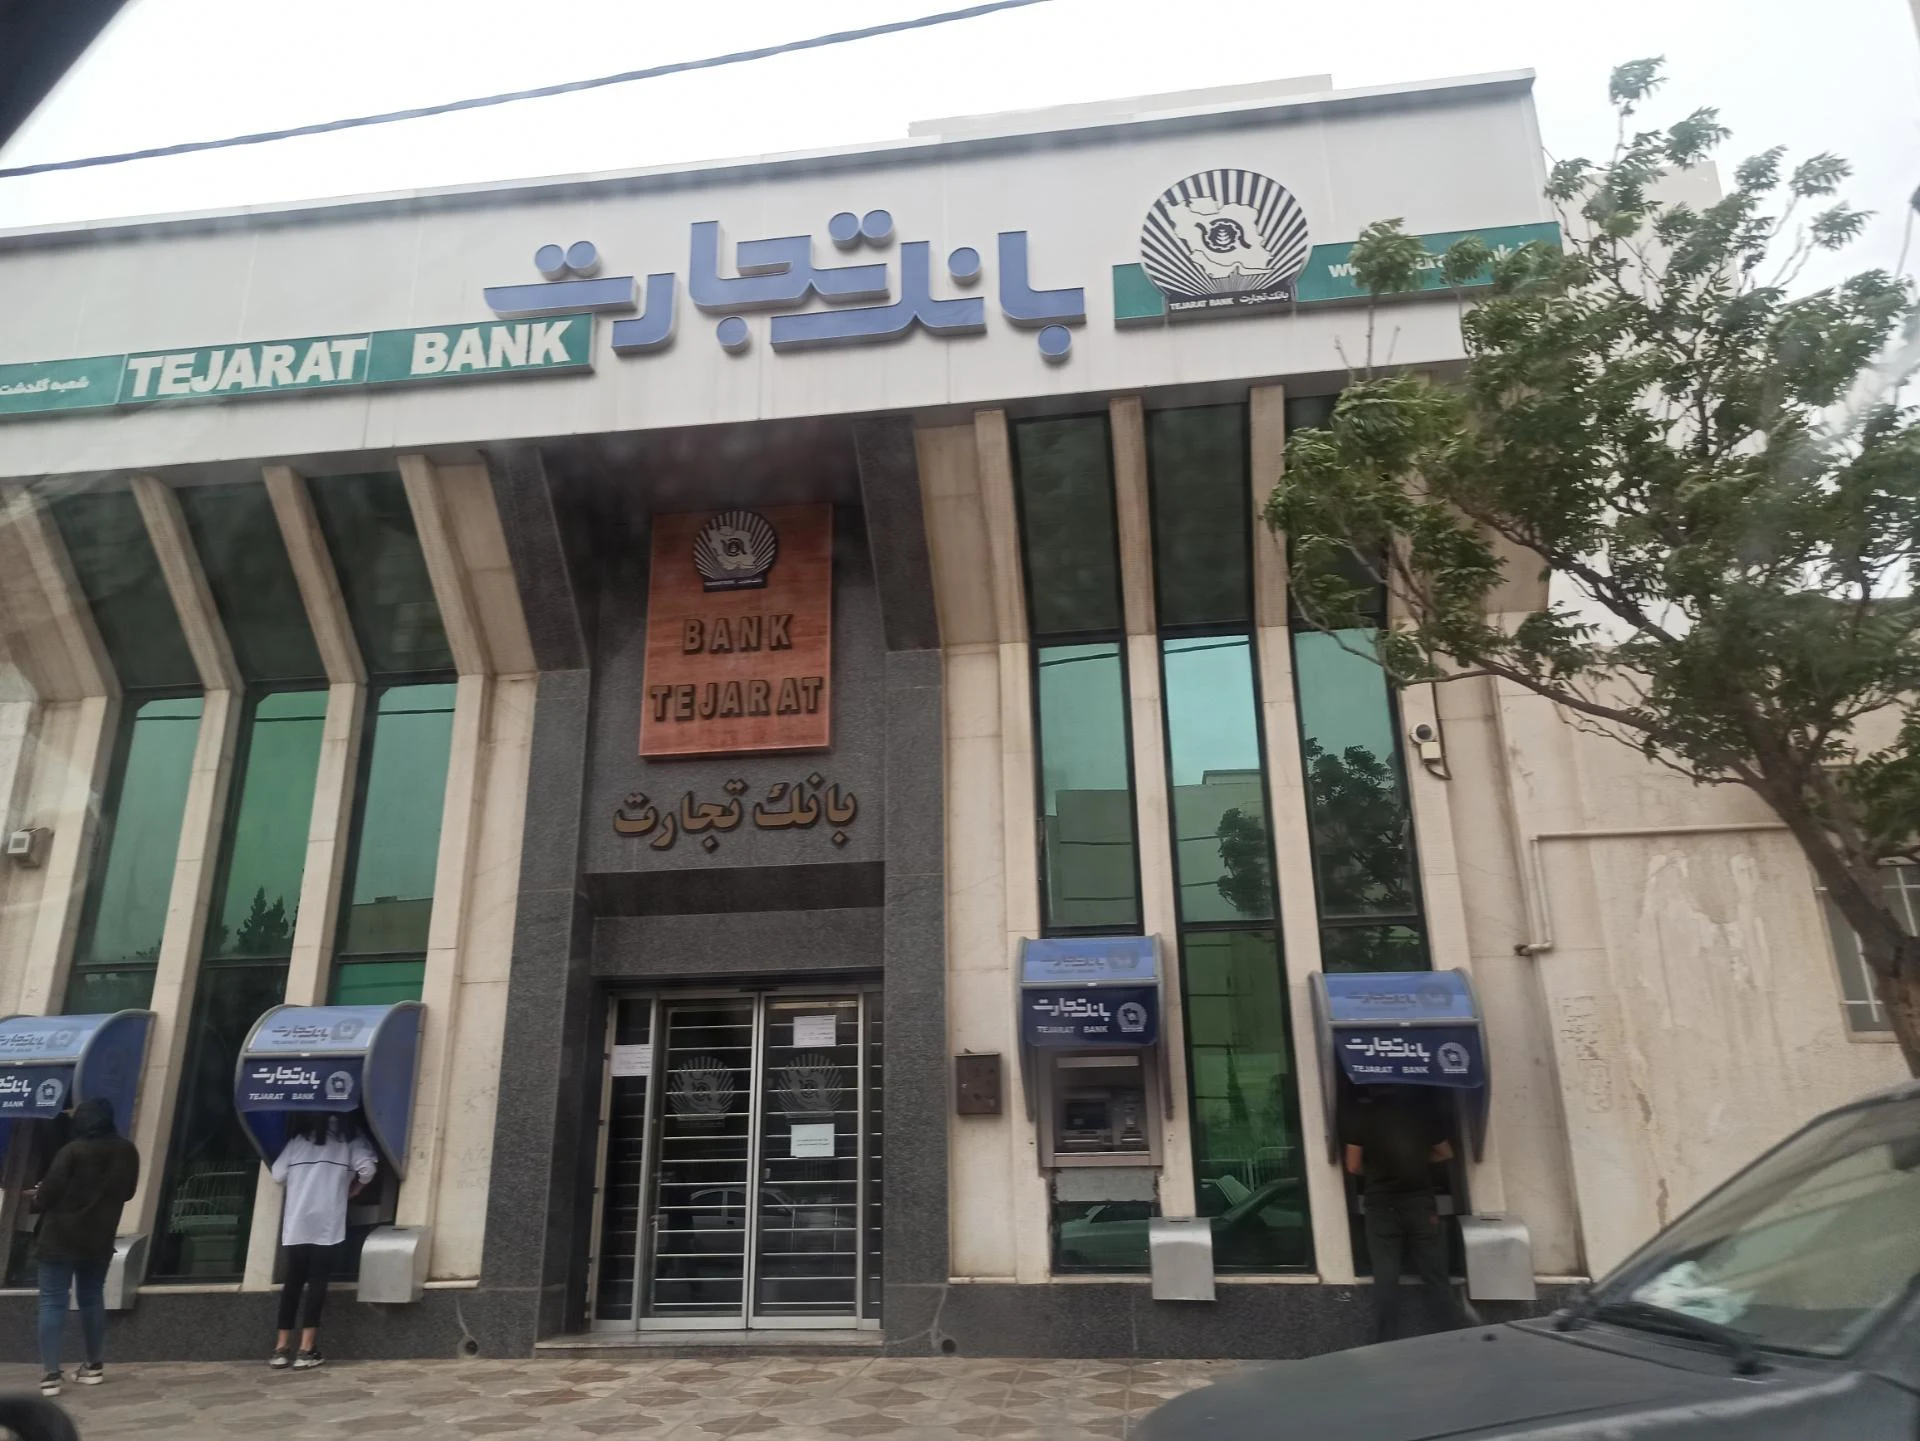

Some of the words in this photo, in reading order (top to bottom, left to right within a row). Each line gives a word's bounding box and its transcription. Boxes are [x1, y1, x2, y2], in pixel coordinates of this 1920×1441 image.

[483, 209, 893, 354] تجارت
[128, 337, 368, 398] TEJARAT
[411, 320, 572, 375] BANK
[682, 614, 793, 655] BANK
[651, 677, 823, 722] TEJARAT
[613, 779, 746, 852] تجارت
[1352, 1065, 1393, 1073] TEJARAT
